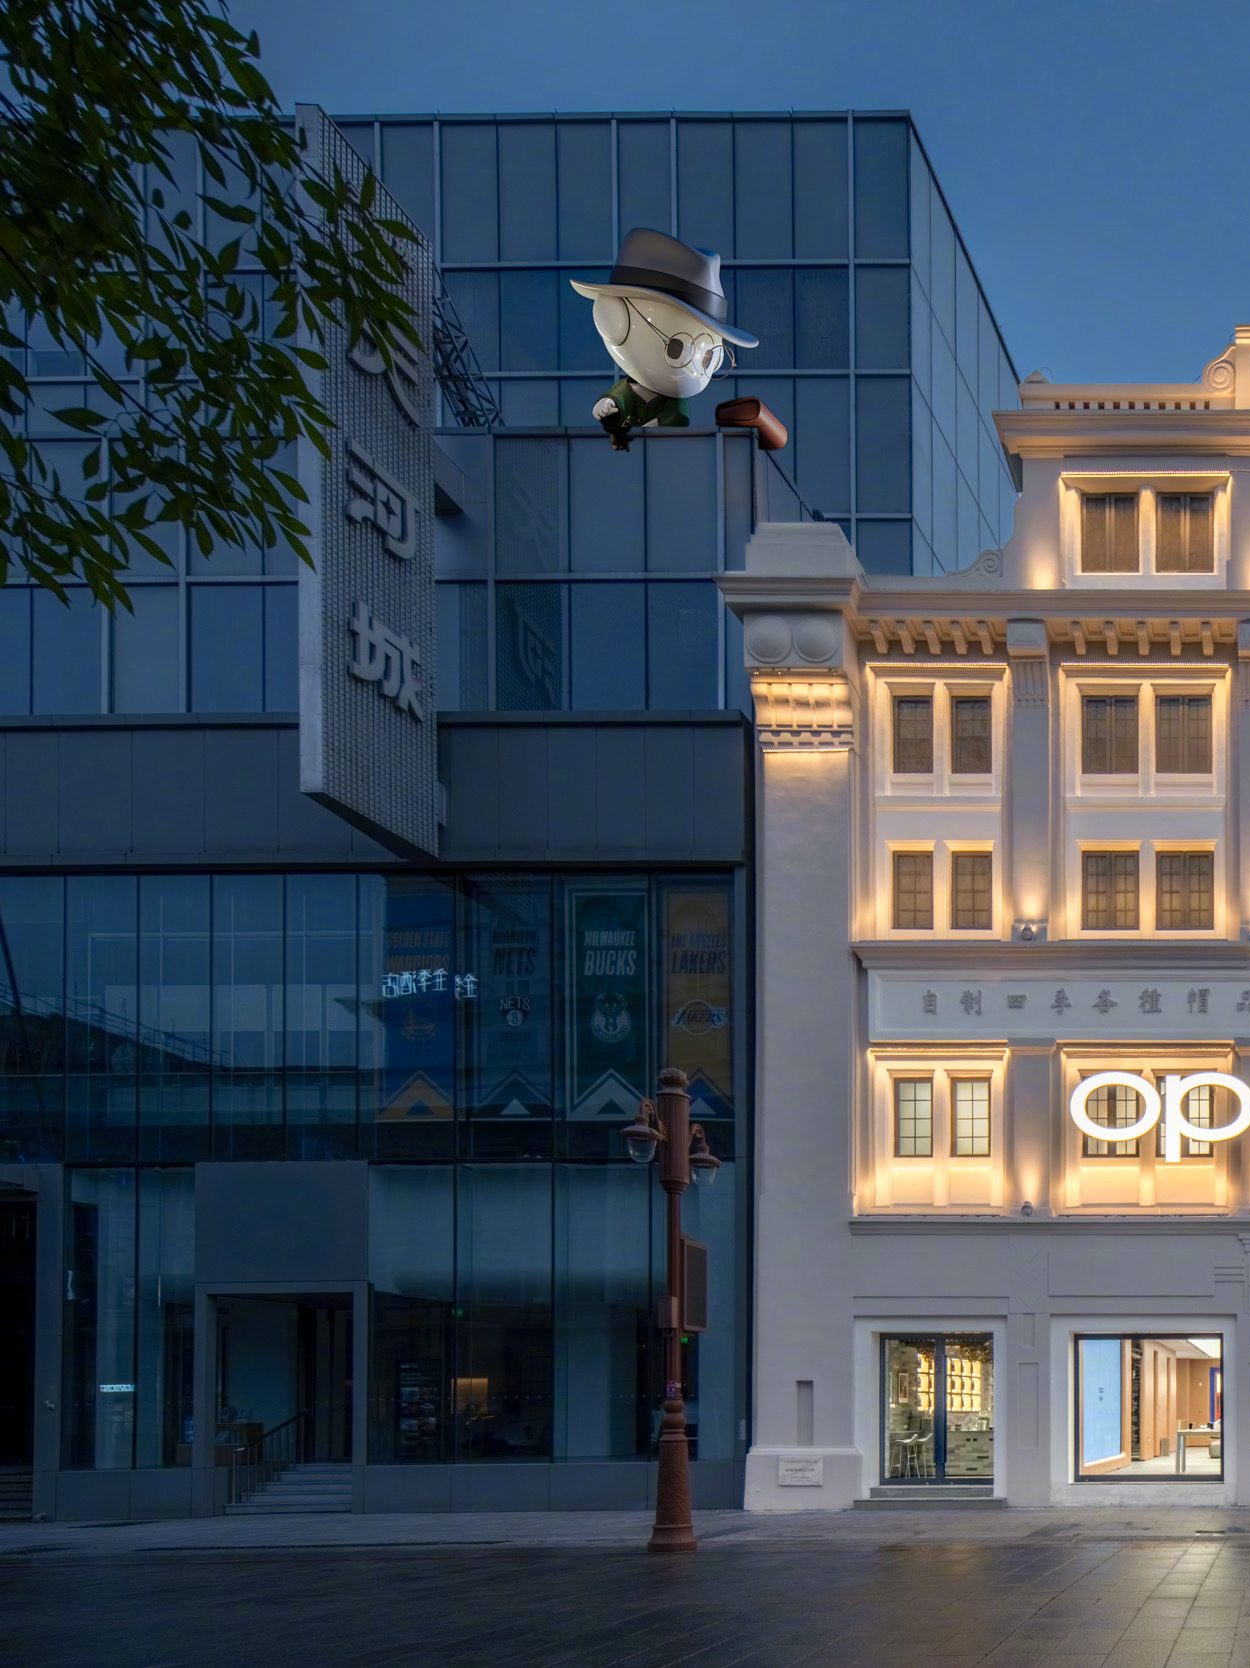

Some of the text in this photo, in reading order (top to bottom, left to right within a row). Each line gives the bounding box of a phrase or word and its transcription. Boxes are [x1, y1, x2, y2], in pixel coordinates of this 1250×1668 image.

[584, 930, 637, 947] MILWAUKEE
[671, 933, 727, 949] LOS ANGELES
[493, 947, 537, 976] NETS
[584, 949, 637, 976] BUCKS
[671, 950, 727, 975] LAKERS
[500, 996, 531, 1012] NETS
